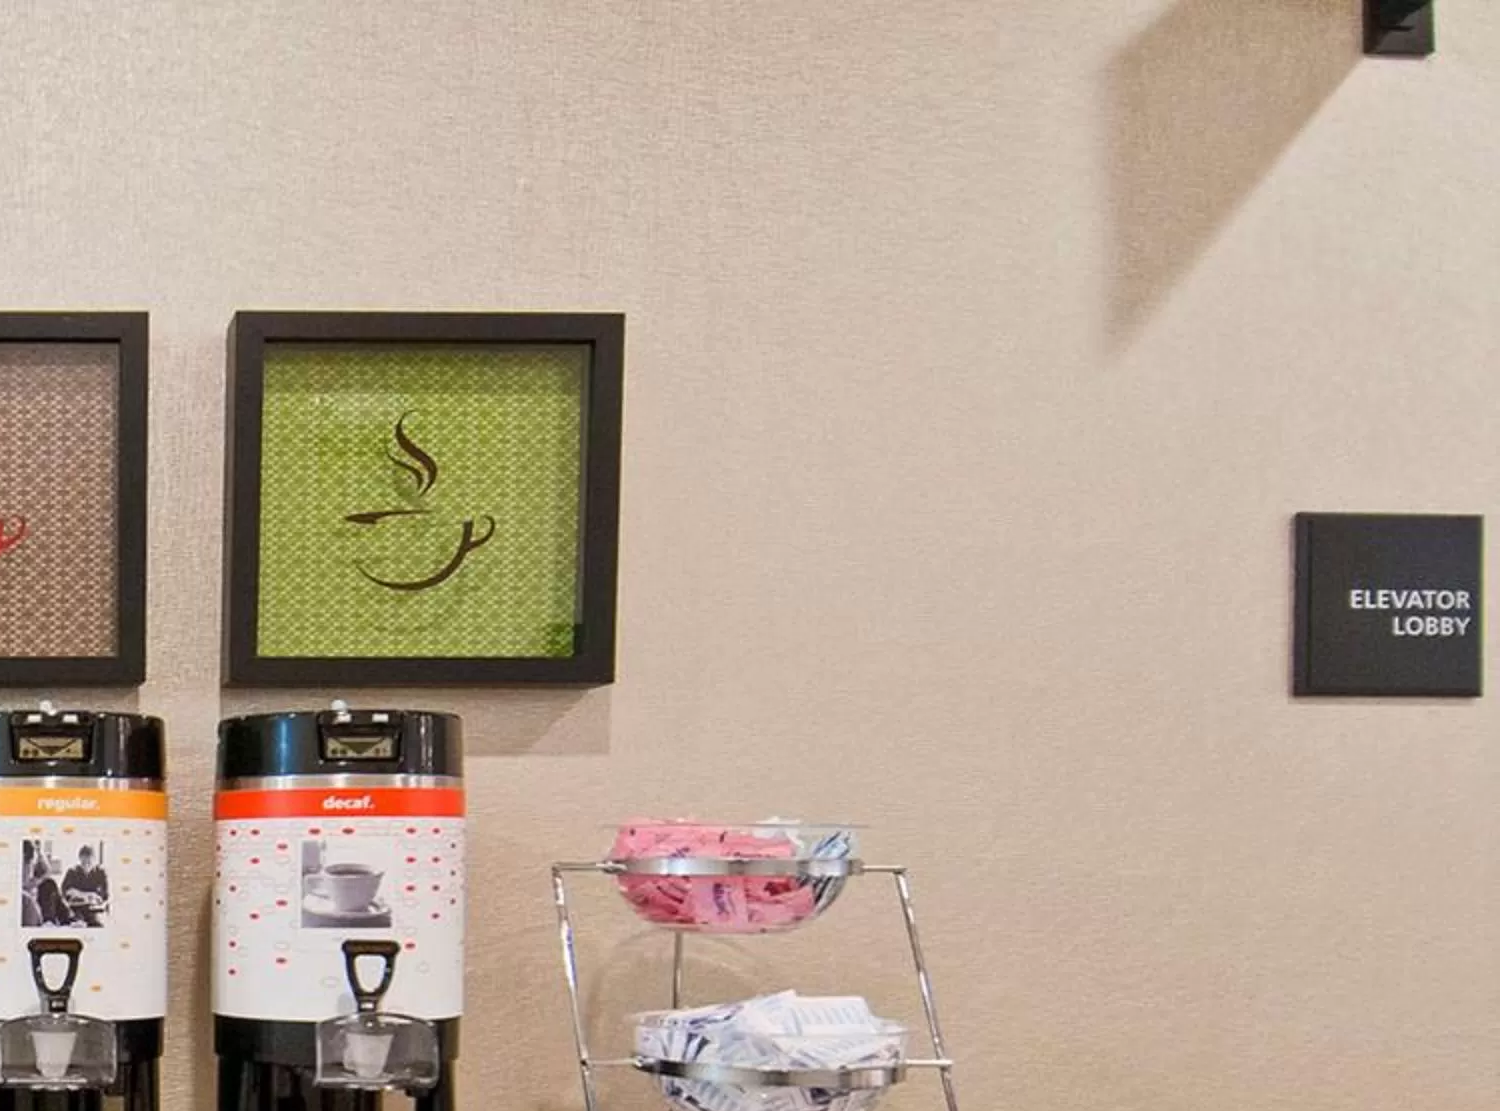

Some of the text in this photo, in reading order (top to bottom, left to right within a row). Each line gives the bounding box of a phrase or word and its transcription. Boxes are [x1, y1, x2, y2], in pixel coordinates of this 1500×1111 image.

[1350, 589, 1471, 609] ELEVATOR
[1393, 616, 1471, 636] LOBBY
[323, 795, 376, 809] decaf.
